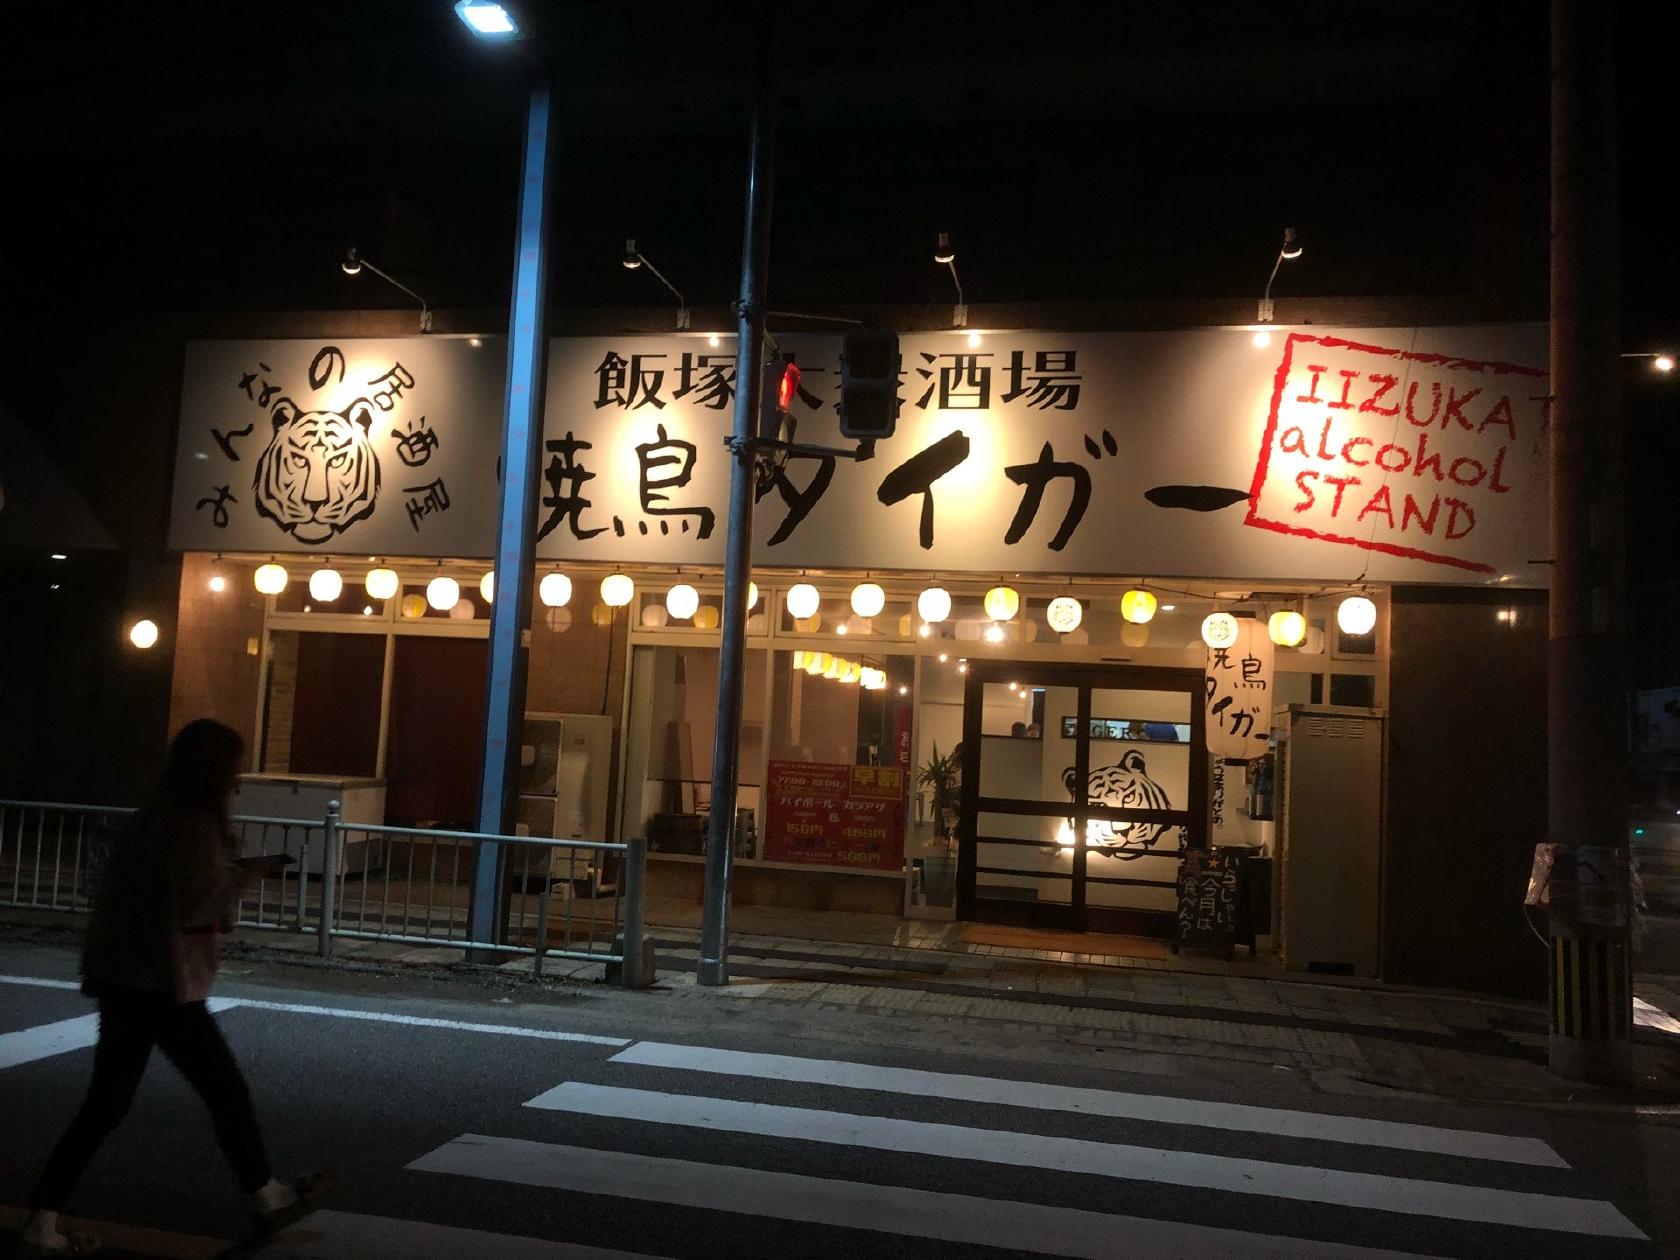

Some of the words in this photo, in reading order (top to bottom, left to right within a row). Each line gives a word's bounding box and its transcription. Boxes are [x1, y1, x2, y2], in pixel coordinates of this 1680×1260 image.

[593, 350, 1082, 412] 飯塚酒場
[1296, 364, 1516, 441] IIZUKA
[195, 345, 451, 533] みんなの居酒屋
[1279, 416, 1513, 494] alcohol
[1293, 469, 1477, 540] STAND
[1197, 878, 1222, 931] 今月は
